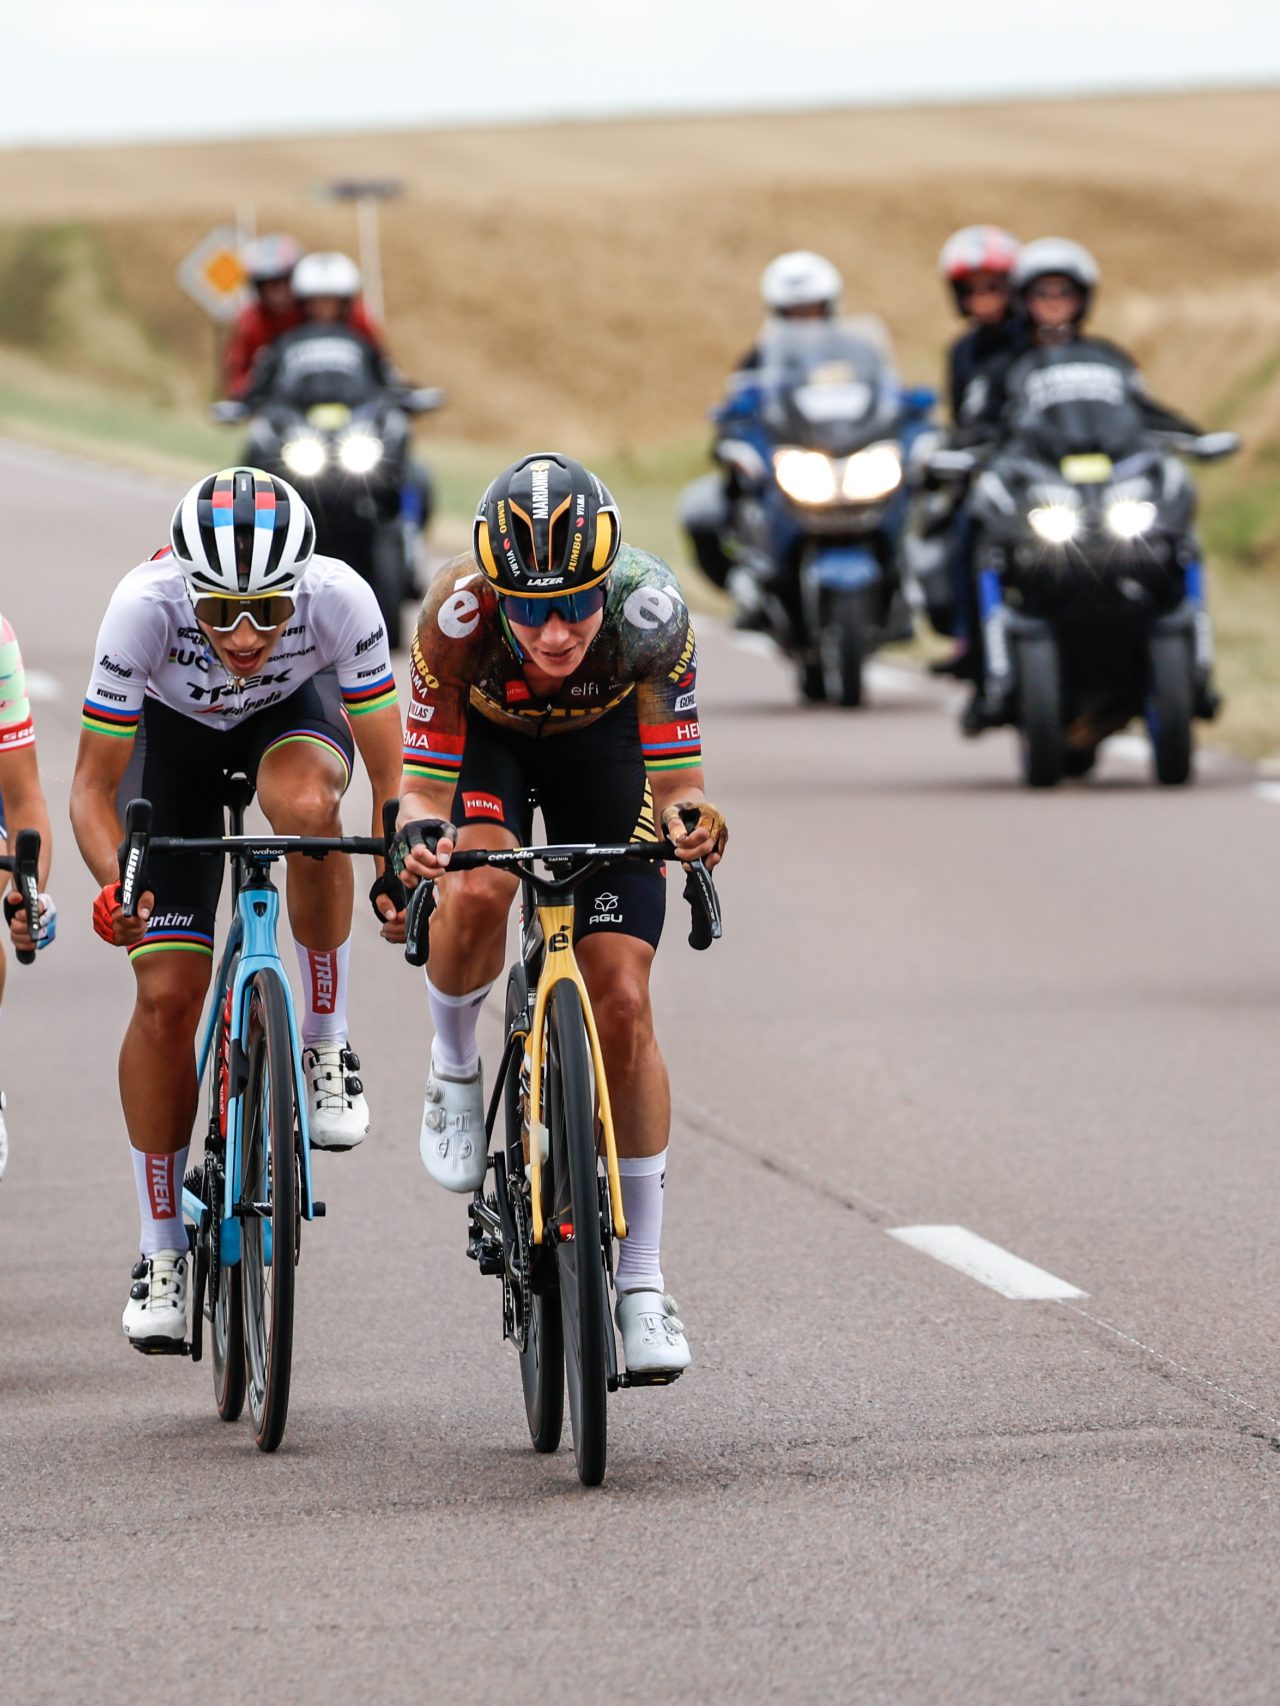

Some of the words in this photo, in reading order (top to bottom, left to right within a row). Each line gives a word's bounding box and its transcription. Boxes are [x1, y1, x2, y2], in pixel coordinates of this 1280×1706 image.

[497, 500, 508, 534] JUMBO
[576, 494, 585, 516] VISMA
[506, 550, 521, 577] VISMA
[567, 533, 582, 572] JUMBO
[526, 577, 565, 586] LAZER
[466, 799, 501, 813] HEMA
[123, 847, 140, 905] SRAM
[589, 913, 624, 925] AGU
[313, 953, 333, 1009] TREK
[151, 1156, 171, 1214] TREK
